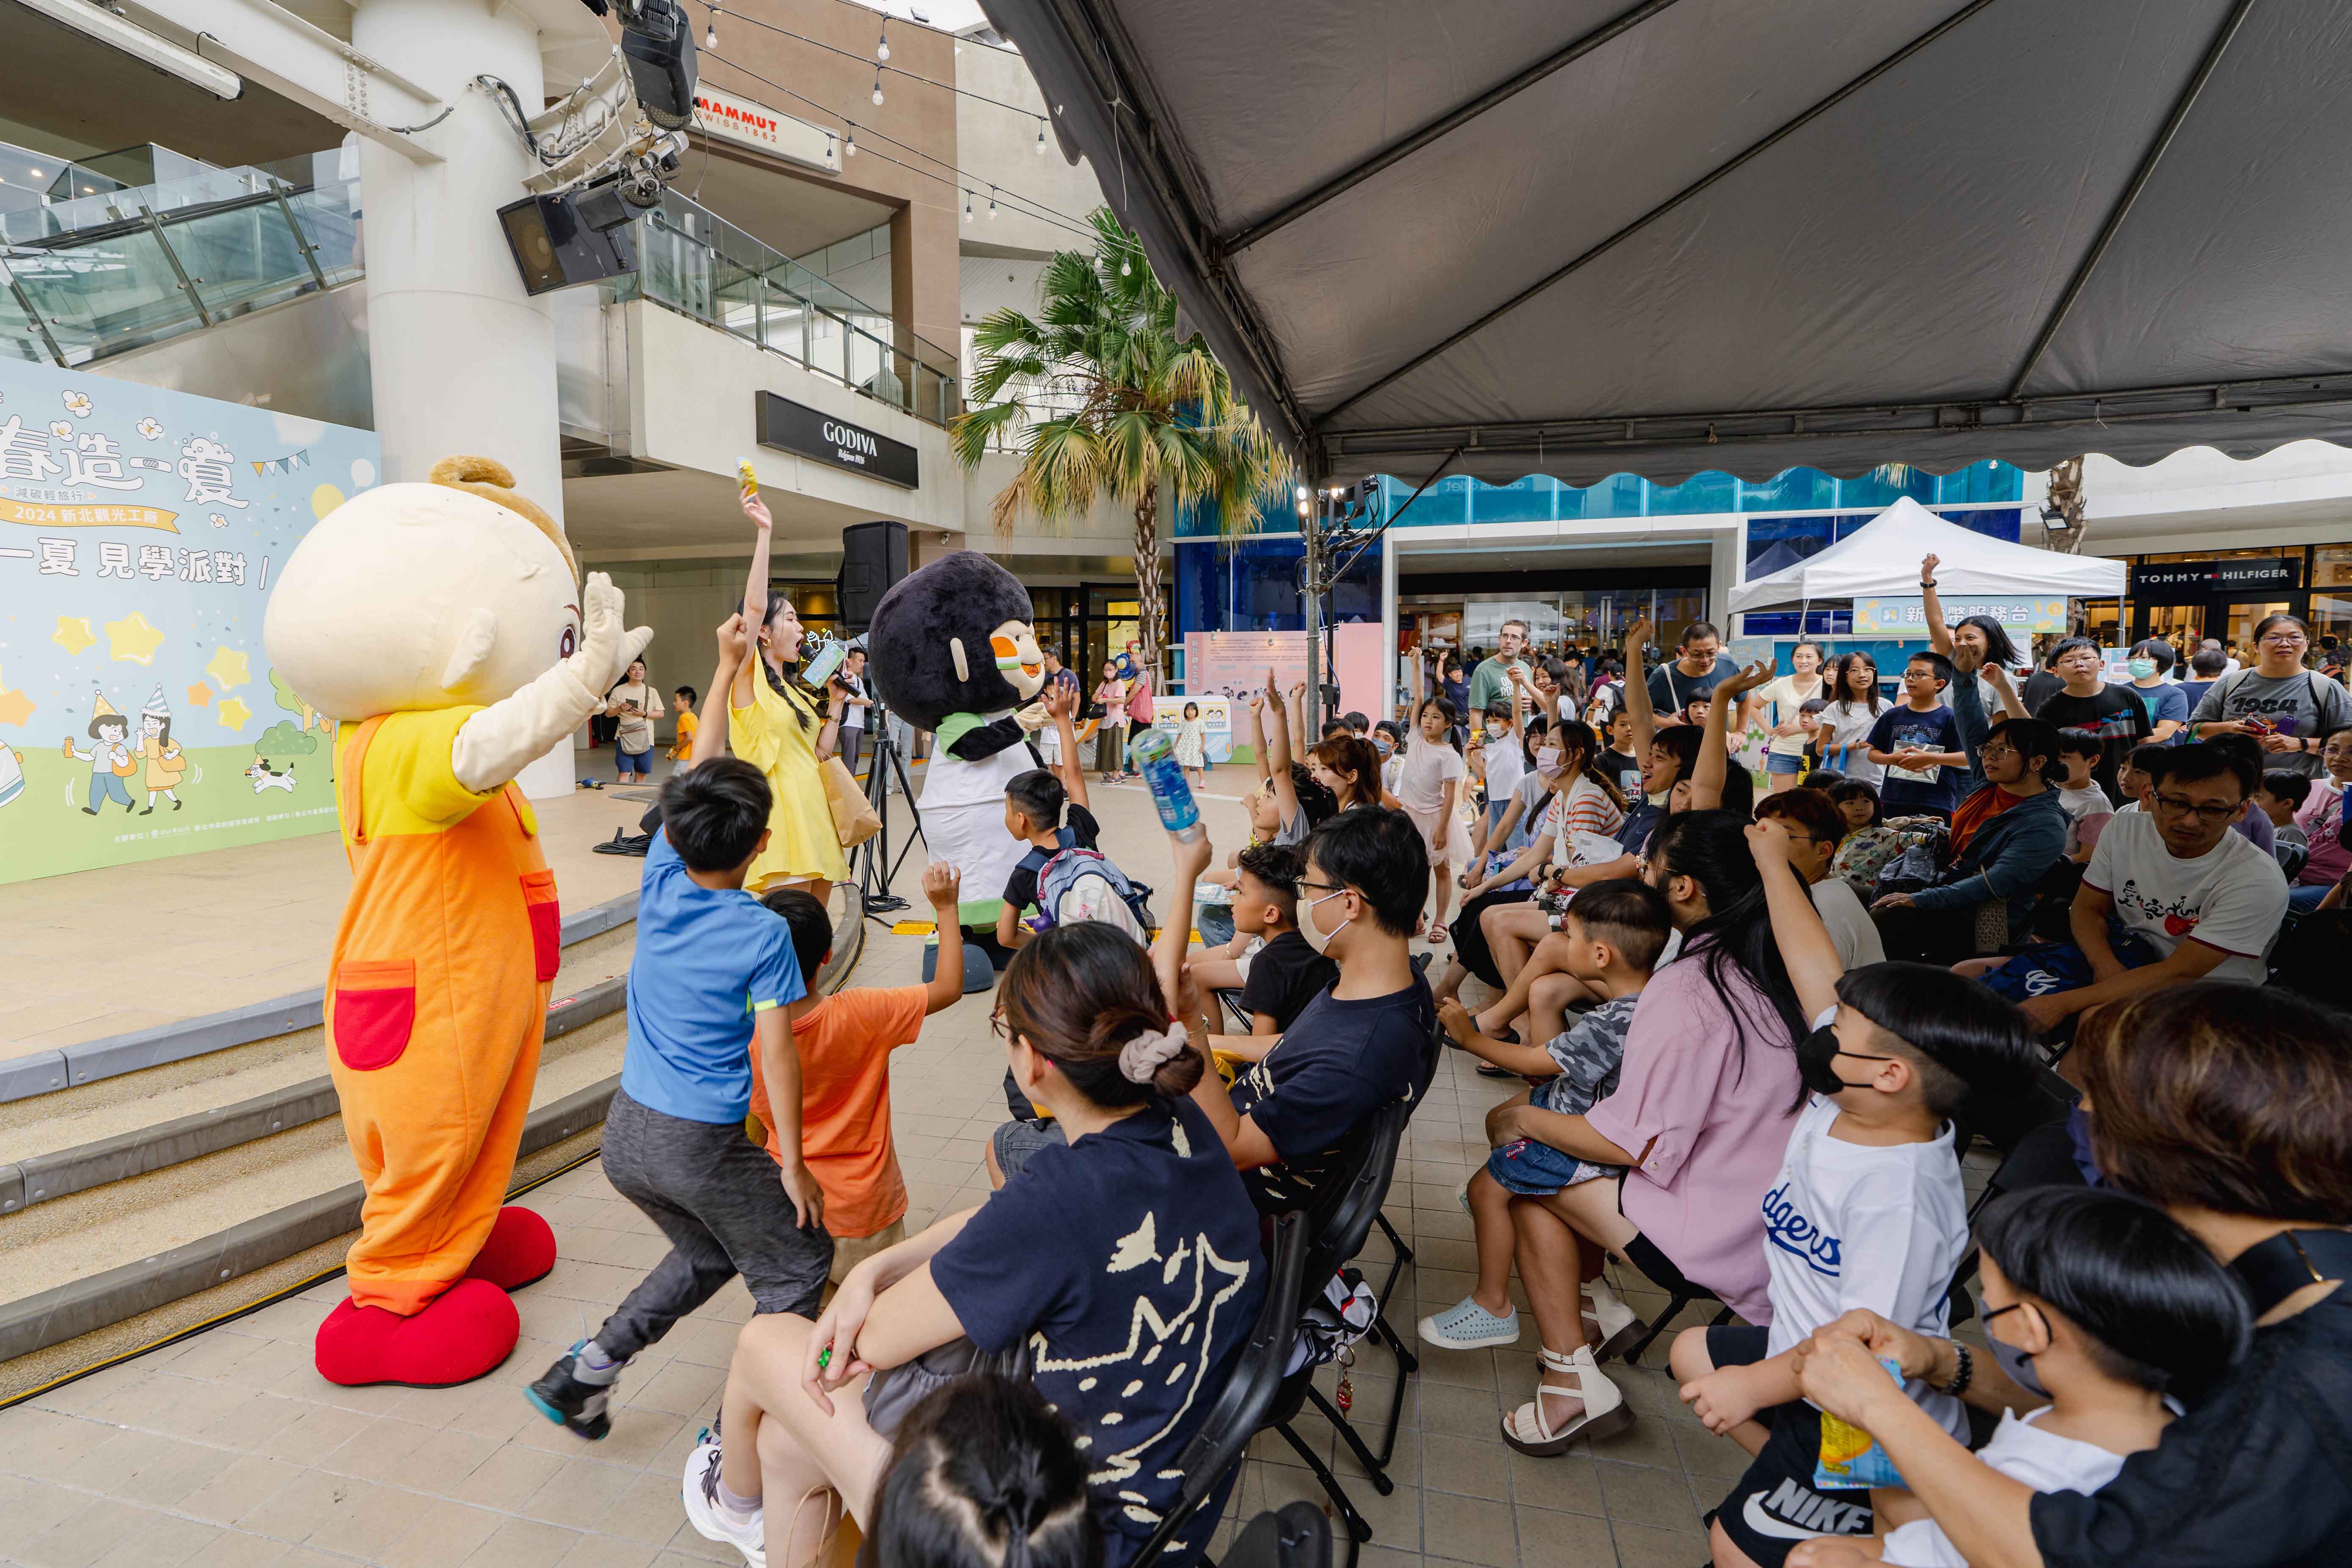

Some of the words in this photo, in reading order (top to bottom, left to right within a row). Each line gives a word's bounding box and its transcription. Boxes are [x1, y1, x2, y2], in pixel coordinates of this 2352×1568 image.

[695, 110, 739, 130] SWISS
[744, 127, 777, 143] 1862
[698, 96, 777, 132] MAMMUT
[823, 421, 878, 457] GODIVA
[15, 486, 83, 502] 減碳輕旅行
[14, 506, 56, 522] 2024
[61, 507, 159, 525] 新北觀光工廠
[97, 542, 248, 586] 見學派對
[2139, 573, 2200, 583] TOMMY
[2222, 569, 2289, 580] HILFIGER
[2232, 697, 2298, 714] 1984
[1762, 1182, 1841, 1266] dgers
[1765, 1476, 1874, 1534] NIKE
